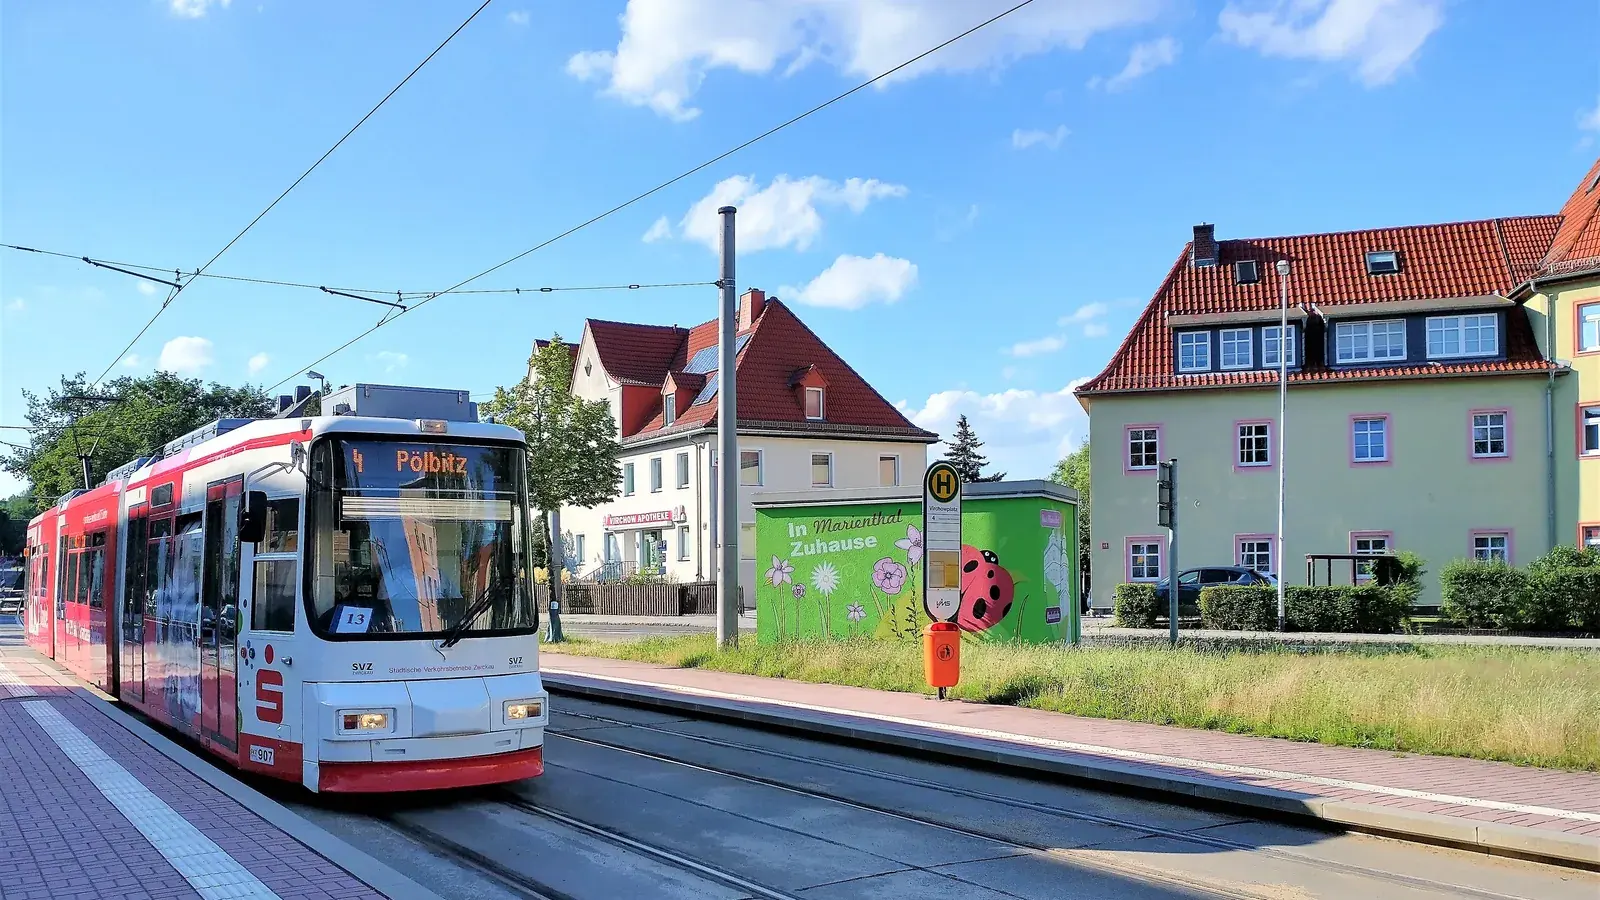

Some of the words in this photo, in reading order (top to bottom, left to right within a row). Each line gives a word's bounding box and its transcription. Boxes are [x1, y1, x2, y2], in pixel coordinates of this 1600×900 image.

[397, 450, 467, 474] Pölbitz
[937, 474, 951, 493] H
[609, 514, 637, 525] VIRCHOW
[638, 512, 669, 523] APOTHEKE
[788, 522, 807, 538] In
[813, 509, 903, 534] Marienthal
[789, 535, 878, 557] Zuhause
[346, 613, 365, 625] 13
[352, 662, 373, 671] SVZ
[508, 657, 523, 665] SVZ
[258, 749, 273, 762] 907
